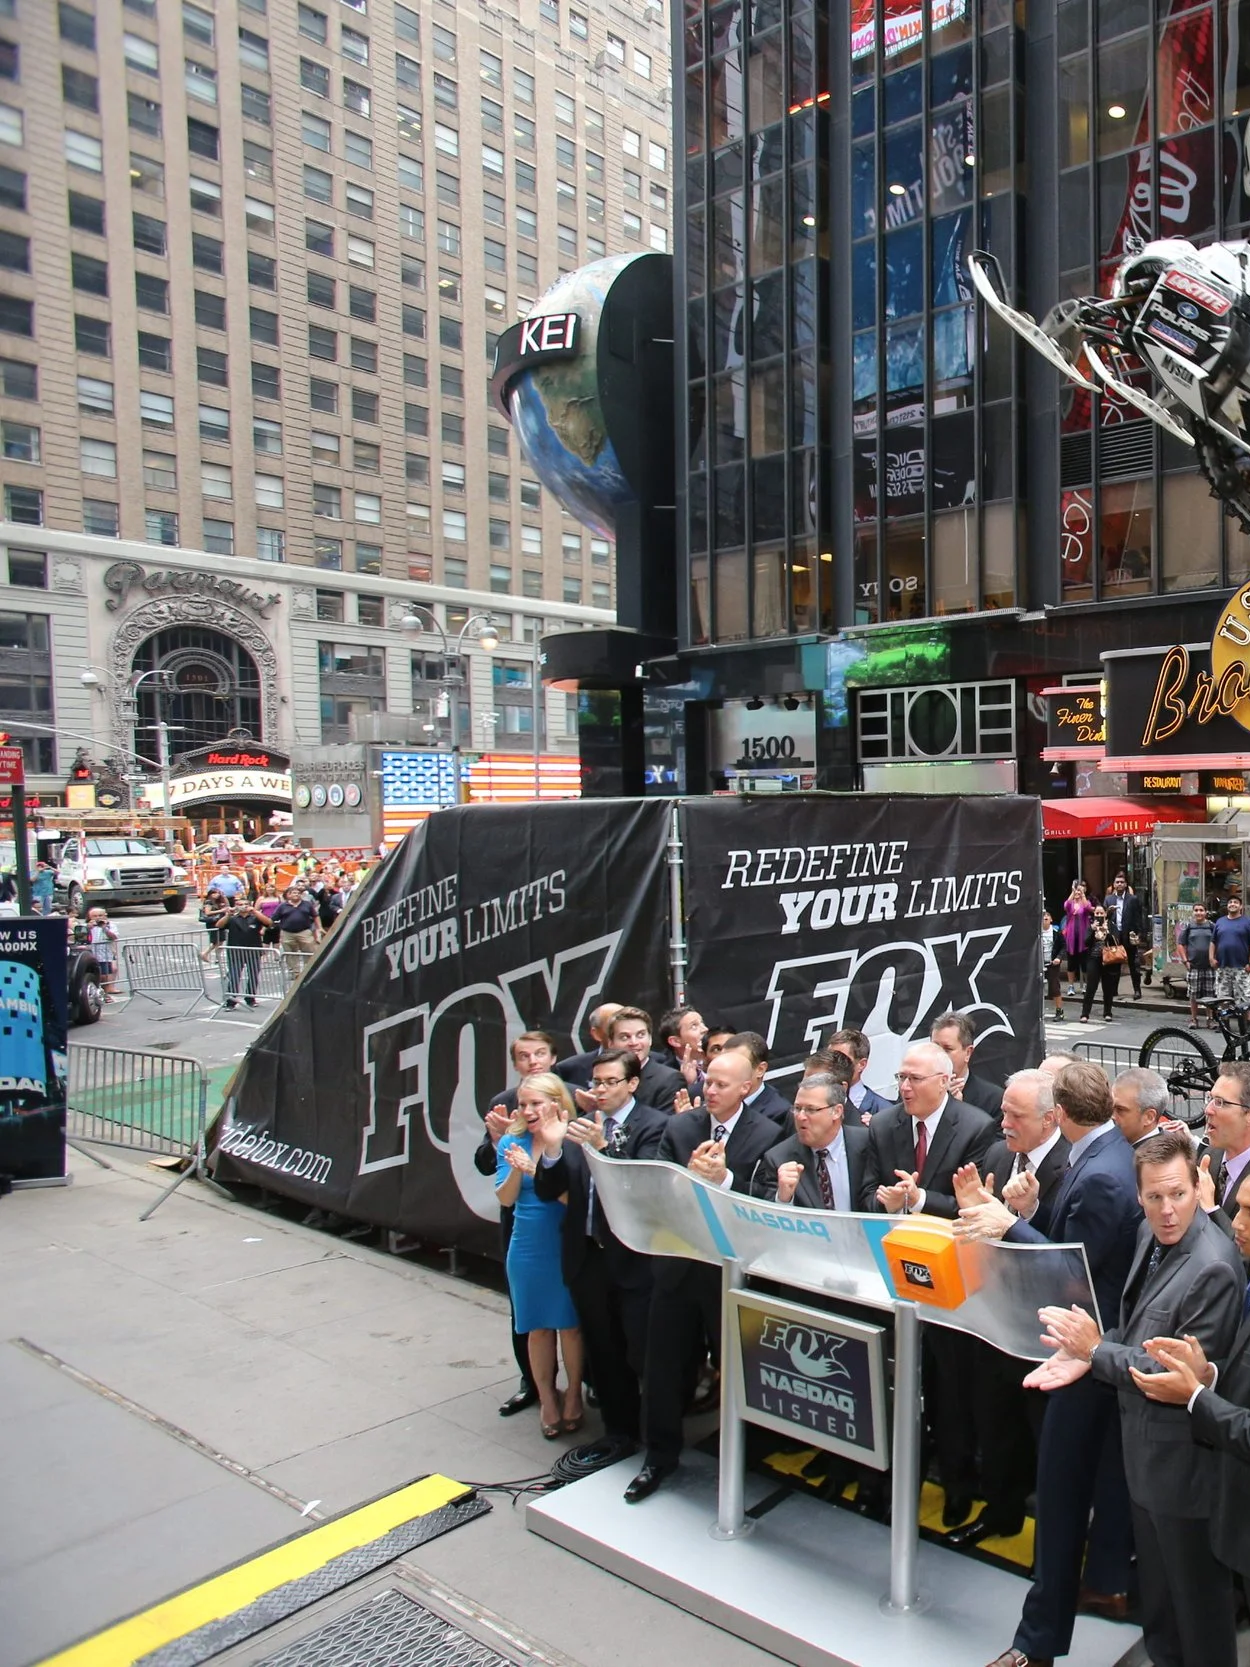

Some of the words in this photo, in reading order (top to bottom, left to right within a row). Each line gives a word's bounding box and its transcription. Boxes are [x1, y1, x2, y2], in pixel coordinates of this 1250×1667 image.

[1149, 301, 1213, 342] POLARIS
[104, 561, 282, 620] Paramount
[1057, 708, 1094, 727] Finer
[1076, 697, 1095, 709] The
[208, 753, 239, 766] Hard
[240, 754, 270, 767] Rock
[741, 735, 795, 761] 1500
[182, 776, 234, 795] DAYS
[240, 776, 254, 788] A
[1143, 776, 1182, 789] RESTAURANT
[721, 840, 909, 890] REDEFINE
[361, 873, 458, 951] REDEFINE
[385, 917, 460, 980] YOUR
[464, 869, 566, 950] LIMITS
[778, 882, 900, 935] YOUR
[903, 870, 1024, 919] LIMITS
[18, 930, 38, 940] US
[764, 925, 1013, 1082] FOX
[358, 929, 624, 1195] FOX
[731, 1202, 832, 1243] NASDAQ
[904, 1263, 931, 1280] FOX
[760, 1316, 850, 1370] FOX
[760, 1368, 856, 1421] NASDAQ
[762, 1393, 857, 1440] LISTED
